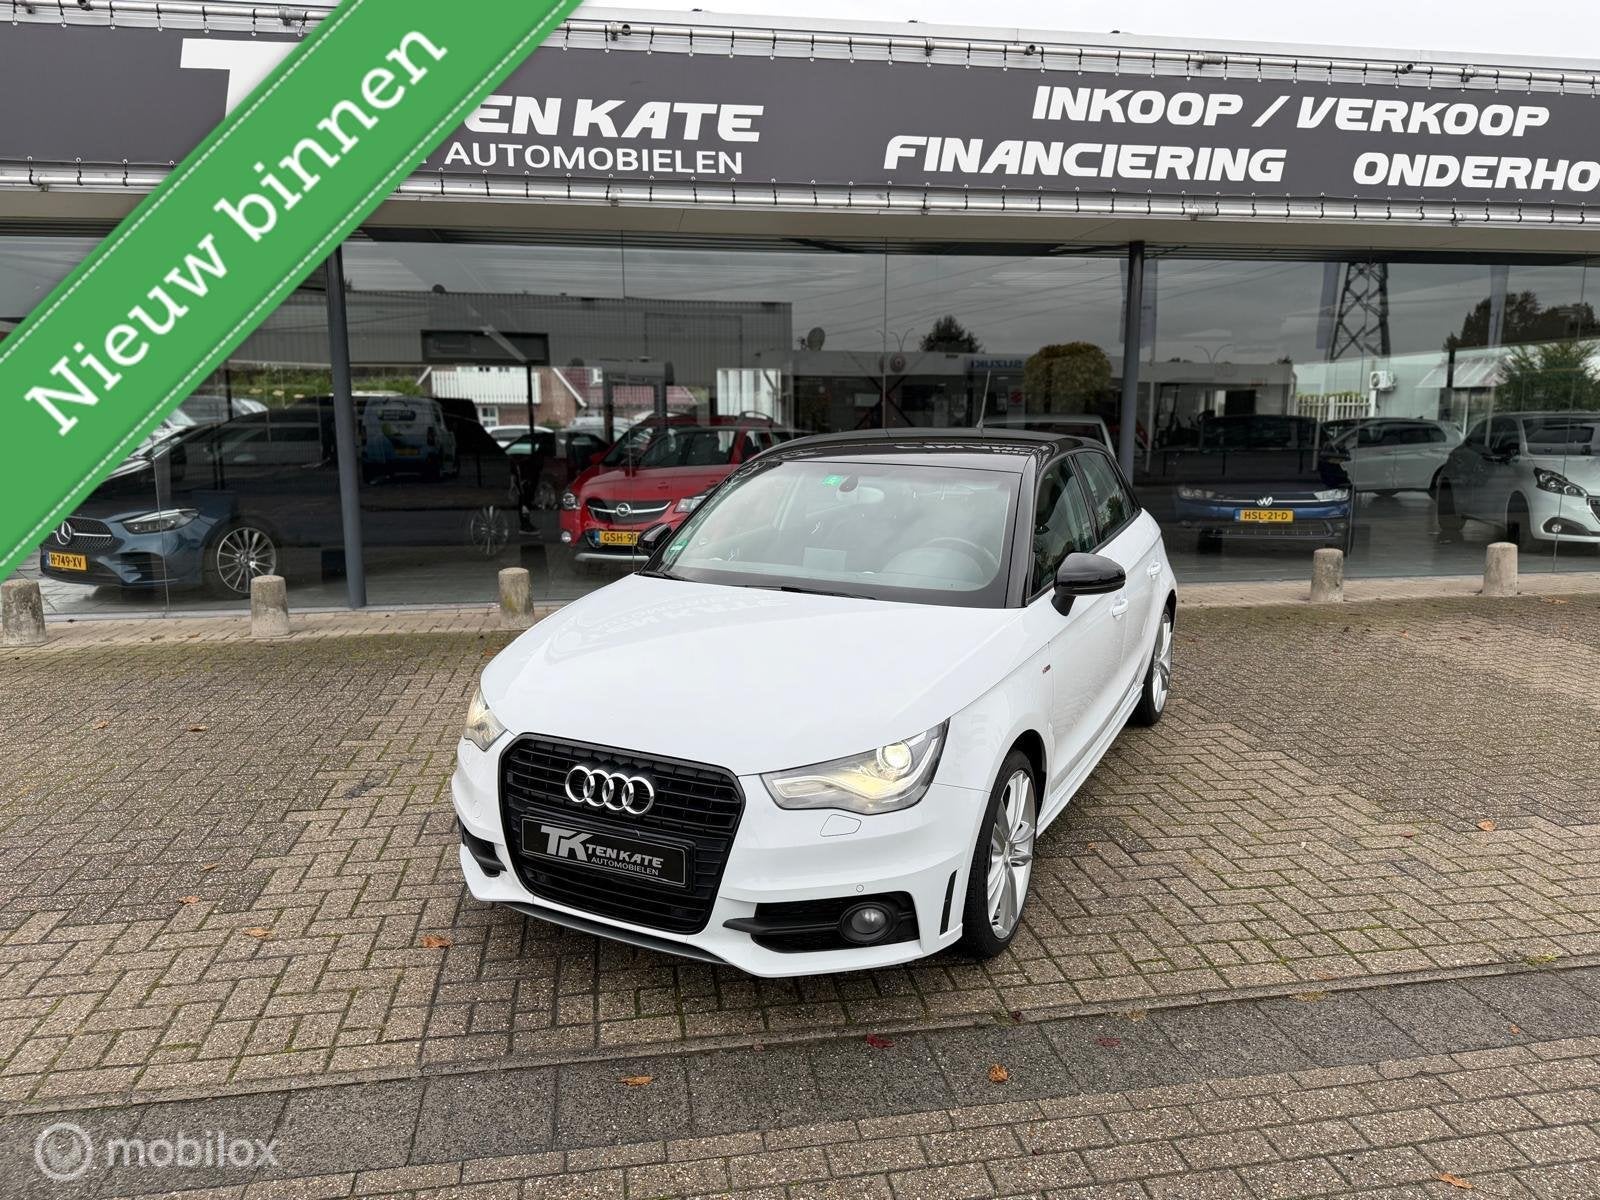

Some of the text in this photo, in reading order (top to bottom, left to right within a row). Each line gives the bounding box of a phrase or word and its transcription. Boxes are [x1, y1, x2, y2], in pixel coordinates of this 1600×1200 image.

[464, 94, 764, 142] EN KATE
[1032, 86, 1243, 126] INKOOP
[1296, 96, 1550, 137] VERKOOP
[444, 141, 743, 174] AUTOMOBIELEN
[883, 135, 1287, 182] FINANCIERING
[1353, 152, 1600, 192] ONDERHO
[1244, 511, 1288, 520] HSL-21-D
[540, 825, 594, 862] TK
[585, 843, 665, 869] TEN KATE
[591, 856, 659, 876] AUTOMOBIELEN
